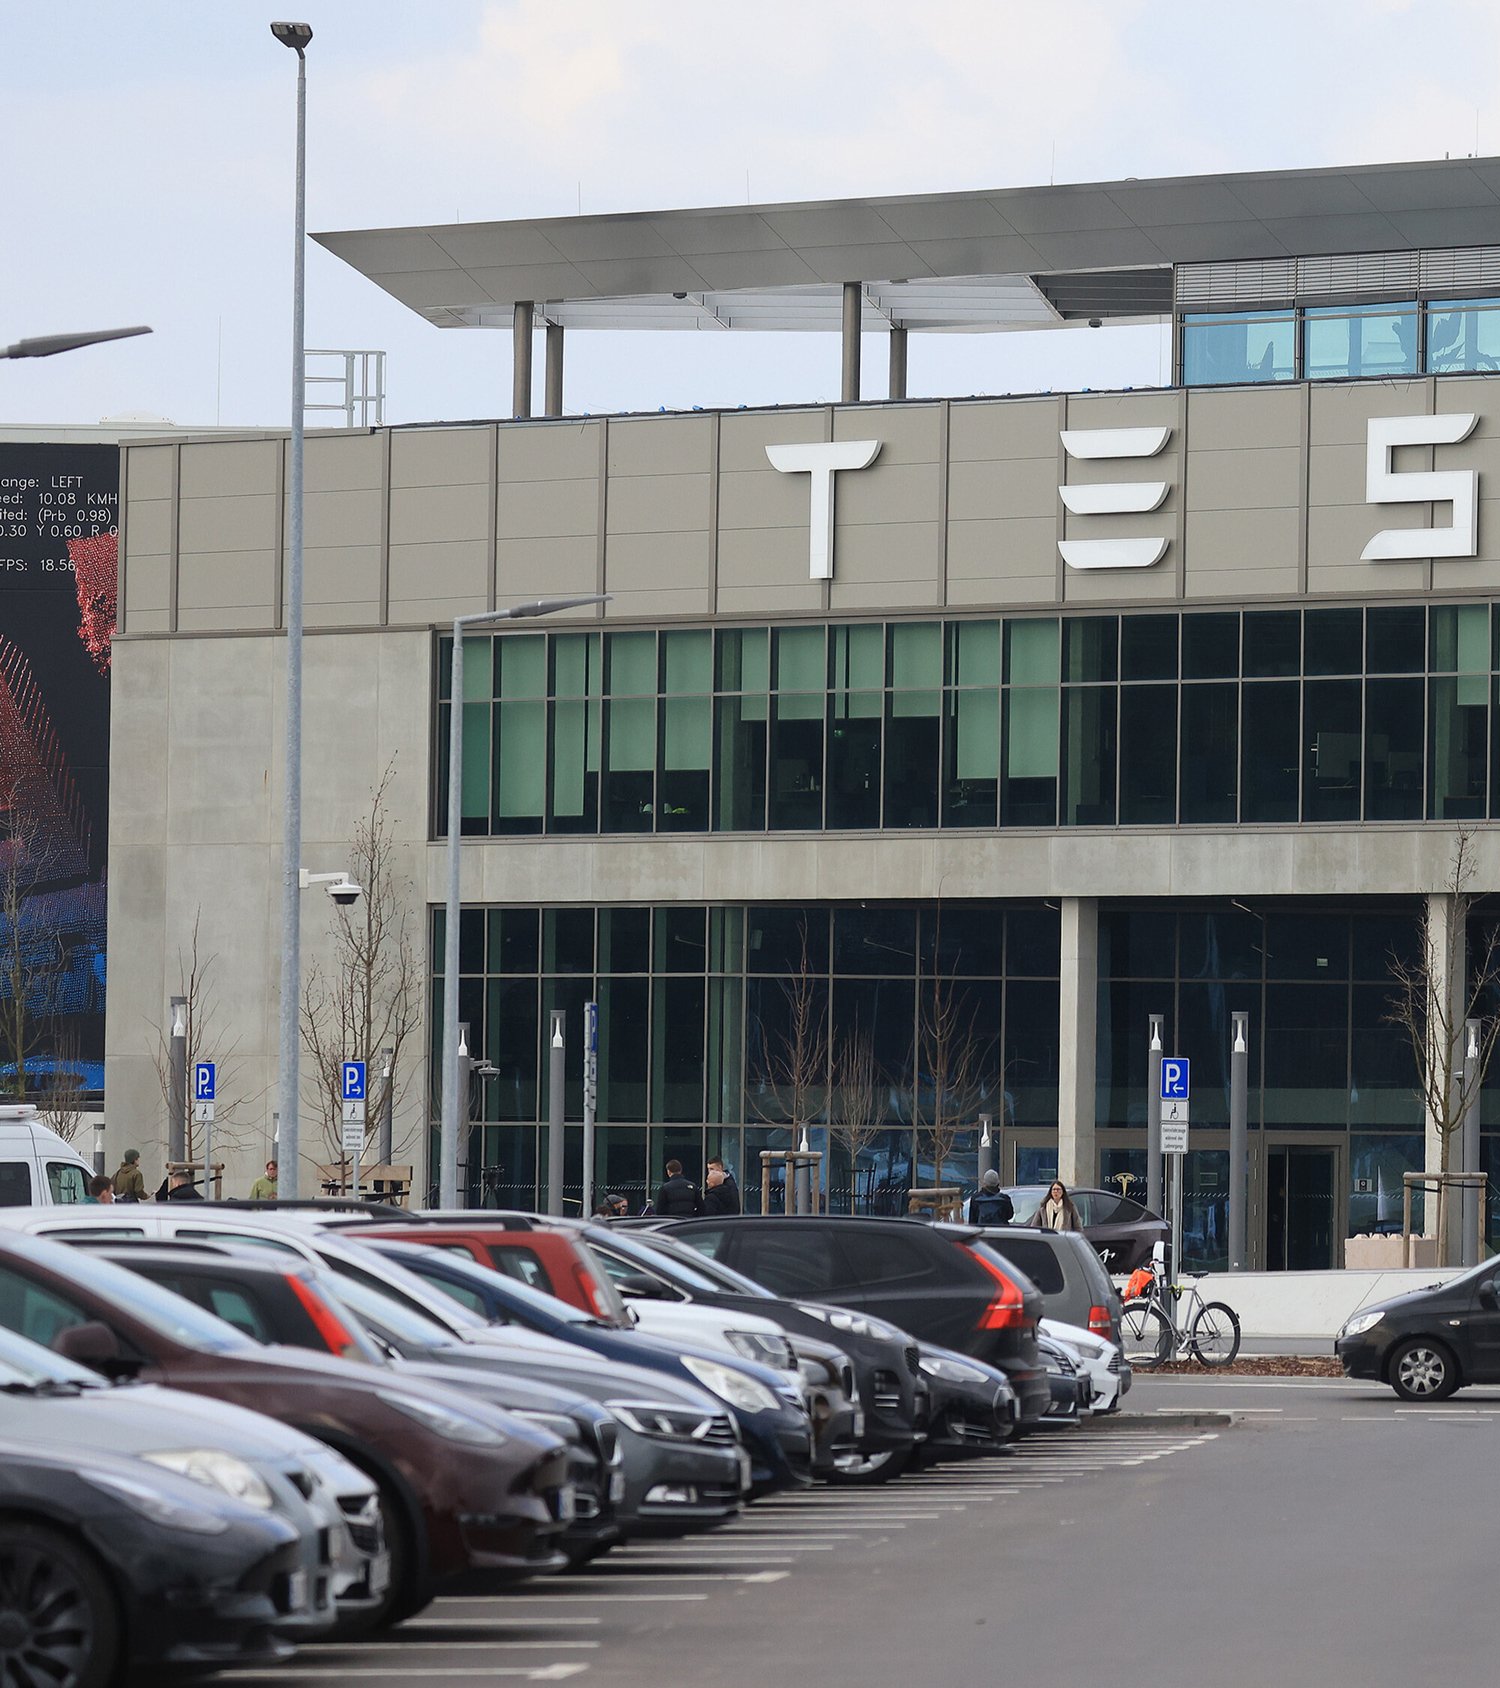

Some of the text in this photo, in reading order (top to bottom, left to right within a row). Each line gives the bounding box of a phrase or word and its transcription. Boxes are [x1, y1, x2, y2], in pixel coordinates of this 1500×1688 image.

[51, 476, 83, 488] LEFT
[0, 492, 118, 505] ed: 10.08 KMH
[38, 507, 66, 524] (Prb
[76, 507, 111, 524] 0.98)
[36, 524, 45, 537] Y
[50, 524, 82, 537] 0.60
[91, 525, 100, 537] R
[40, 559, 76, 571] 18.56
[198, 1067, 210, 1096] P
[345, 1066, 359, 1095] P
[1165, 1063, 1181, 1094] P
